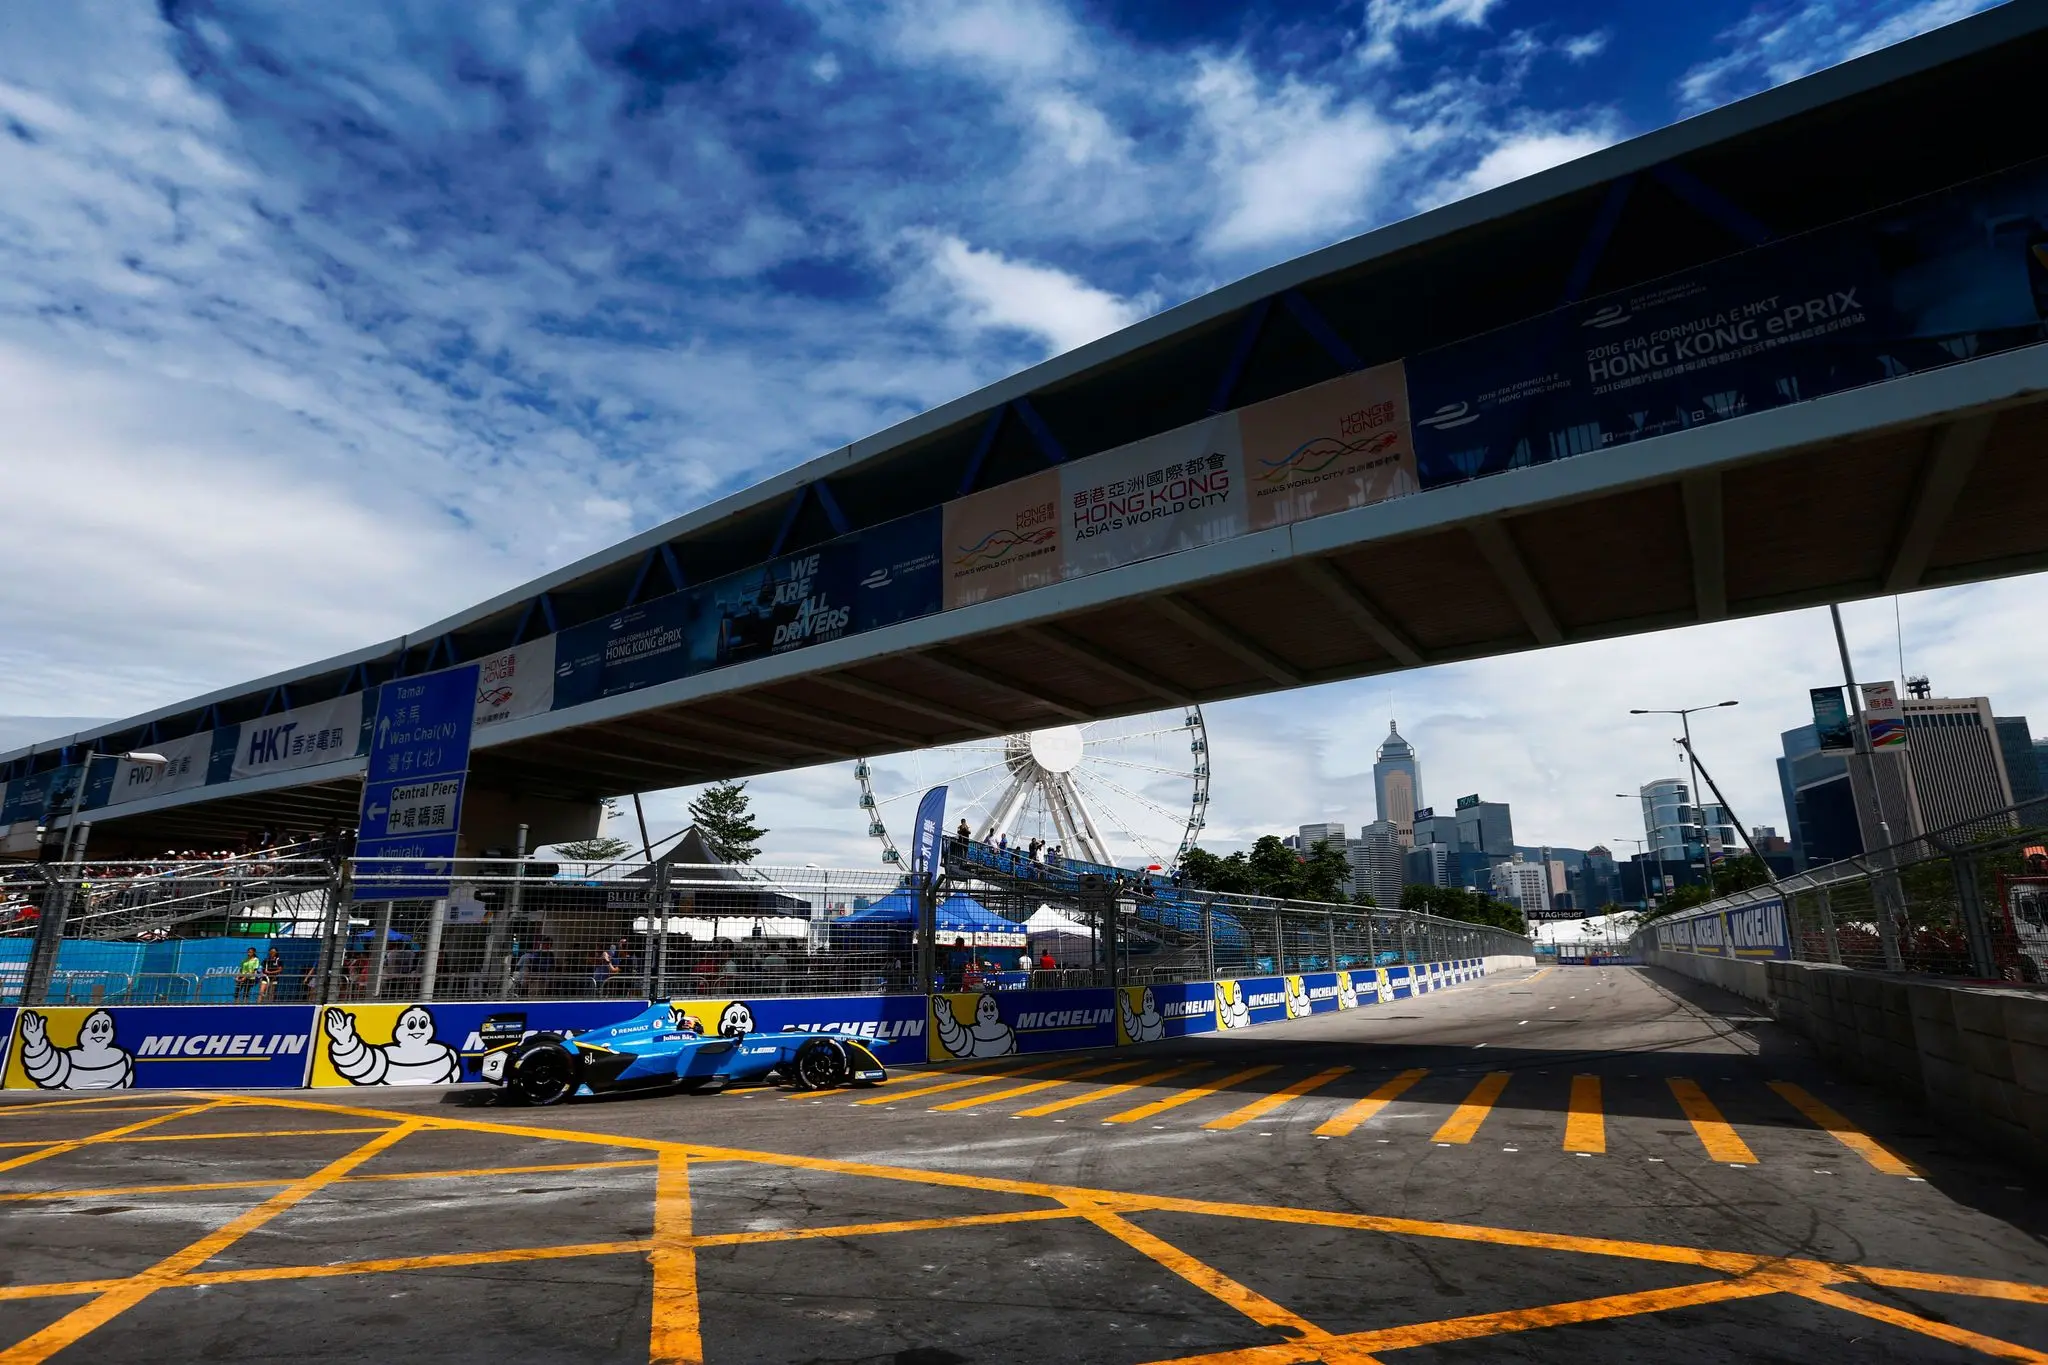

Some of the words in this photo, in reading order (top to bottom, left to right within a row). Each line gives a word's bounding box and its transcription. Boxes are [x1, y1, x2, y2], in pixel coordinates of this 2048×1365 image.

[1586, 342, 1621, 362] 2016
[1624, 335, 1647, 352] FIA
[1650, 314, 1727, 345] FORMULA
[1730, 308, 1741, 322] E
[1743, 295, 1781, 319] HKT
[1588, 345, 1669, 383] HONG
[1675, 319, 1759, 360] KONG
[1765, 286, 1864, 334] ePRIX
[1340, 404, 1383, 427] HONG
[1341, 415, 1383, 438] KONG
[1257, 484, 1286, 498] ASIA'S
[1287, 475, 1321, 489] WORLD
[1322, 467, 1345, 482] CITY
[1074, 492, 1145, 528] HONG
[1150, 470, 1229, 507] KONG
[1016, 504, 1046, 522] HONG
[1016, 512, 1047, 530] KONG
[1075, 518, 1123, 542] ASIA'S
[1126, 501, 1185, 527] WORLD
[1188, 490, 1230, 510] CITY
[790, 553, 820, 581] WE
[976, 561, 1000, 573] WORLD
[1000, 556, 1017, 566] CITY
[771, 577, 811, 608] ARE
[795, 592, 830, 621] ALL
[772, 606, 850, 646] DRIVERS
[606, 643, 631, 660] HONG
[632, 636, 656, 653] KONG
[657, 627, 682, 646] ePRIX
[484, 656, 507, 671] HONG
[483, 668, 507, 684] KONG
[396, 684, 426, 700] Tamar
[392, 704, 421, 727] 添馬
[248, 722, 298, 765] HKT
[293, 727, 343, 756] 香港電訊
[390, 731, 411, 745] Wan
[413, 721, 457, 742] Chai(N)
[128, 765, 153, 787] FWD
[392, 784, 428, 801] Central
[431, 782, 458, 796] Piers
[389, 804, 446, 830] 中環碼頭
[377, 842, 425, 859] Admiralty
[1732, 905, 1785, 946] MICHELIN
[1310, 986, 1338, 1000] MICHELIN
[1356, 981, 1378, 993] MICHELIN
[1163, 1000, 1215, 1017] MICHELIN
[1249, 992, 1286, 1007] MICHELIN
[618, 1025, 649, 1034] RENAULT
[1016, 1008, 1115, 1030] MICHELIN
[136, 1034, 308, 1056] MICHELIN
[489, 1060, 498, 1071] 9
